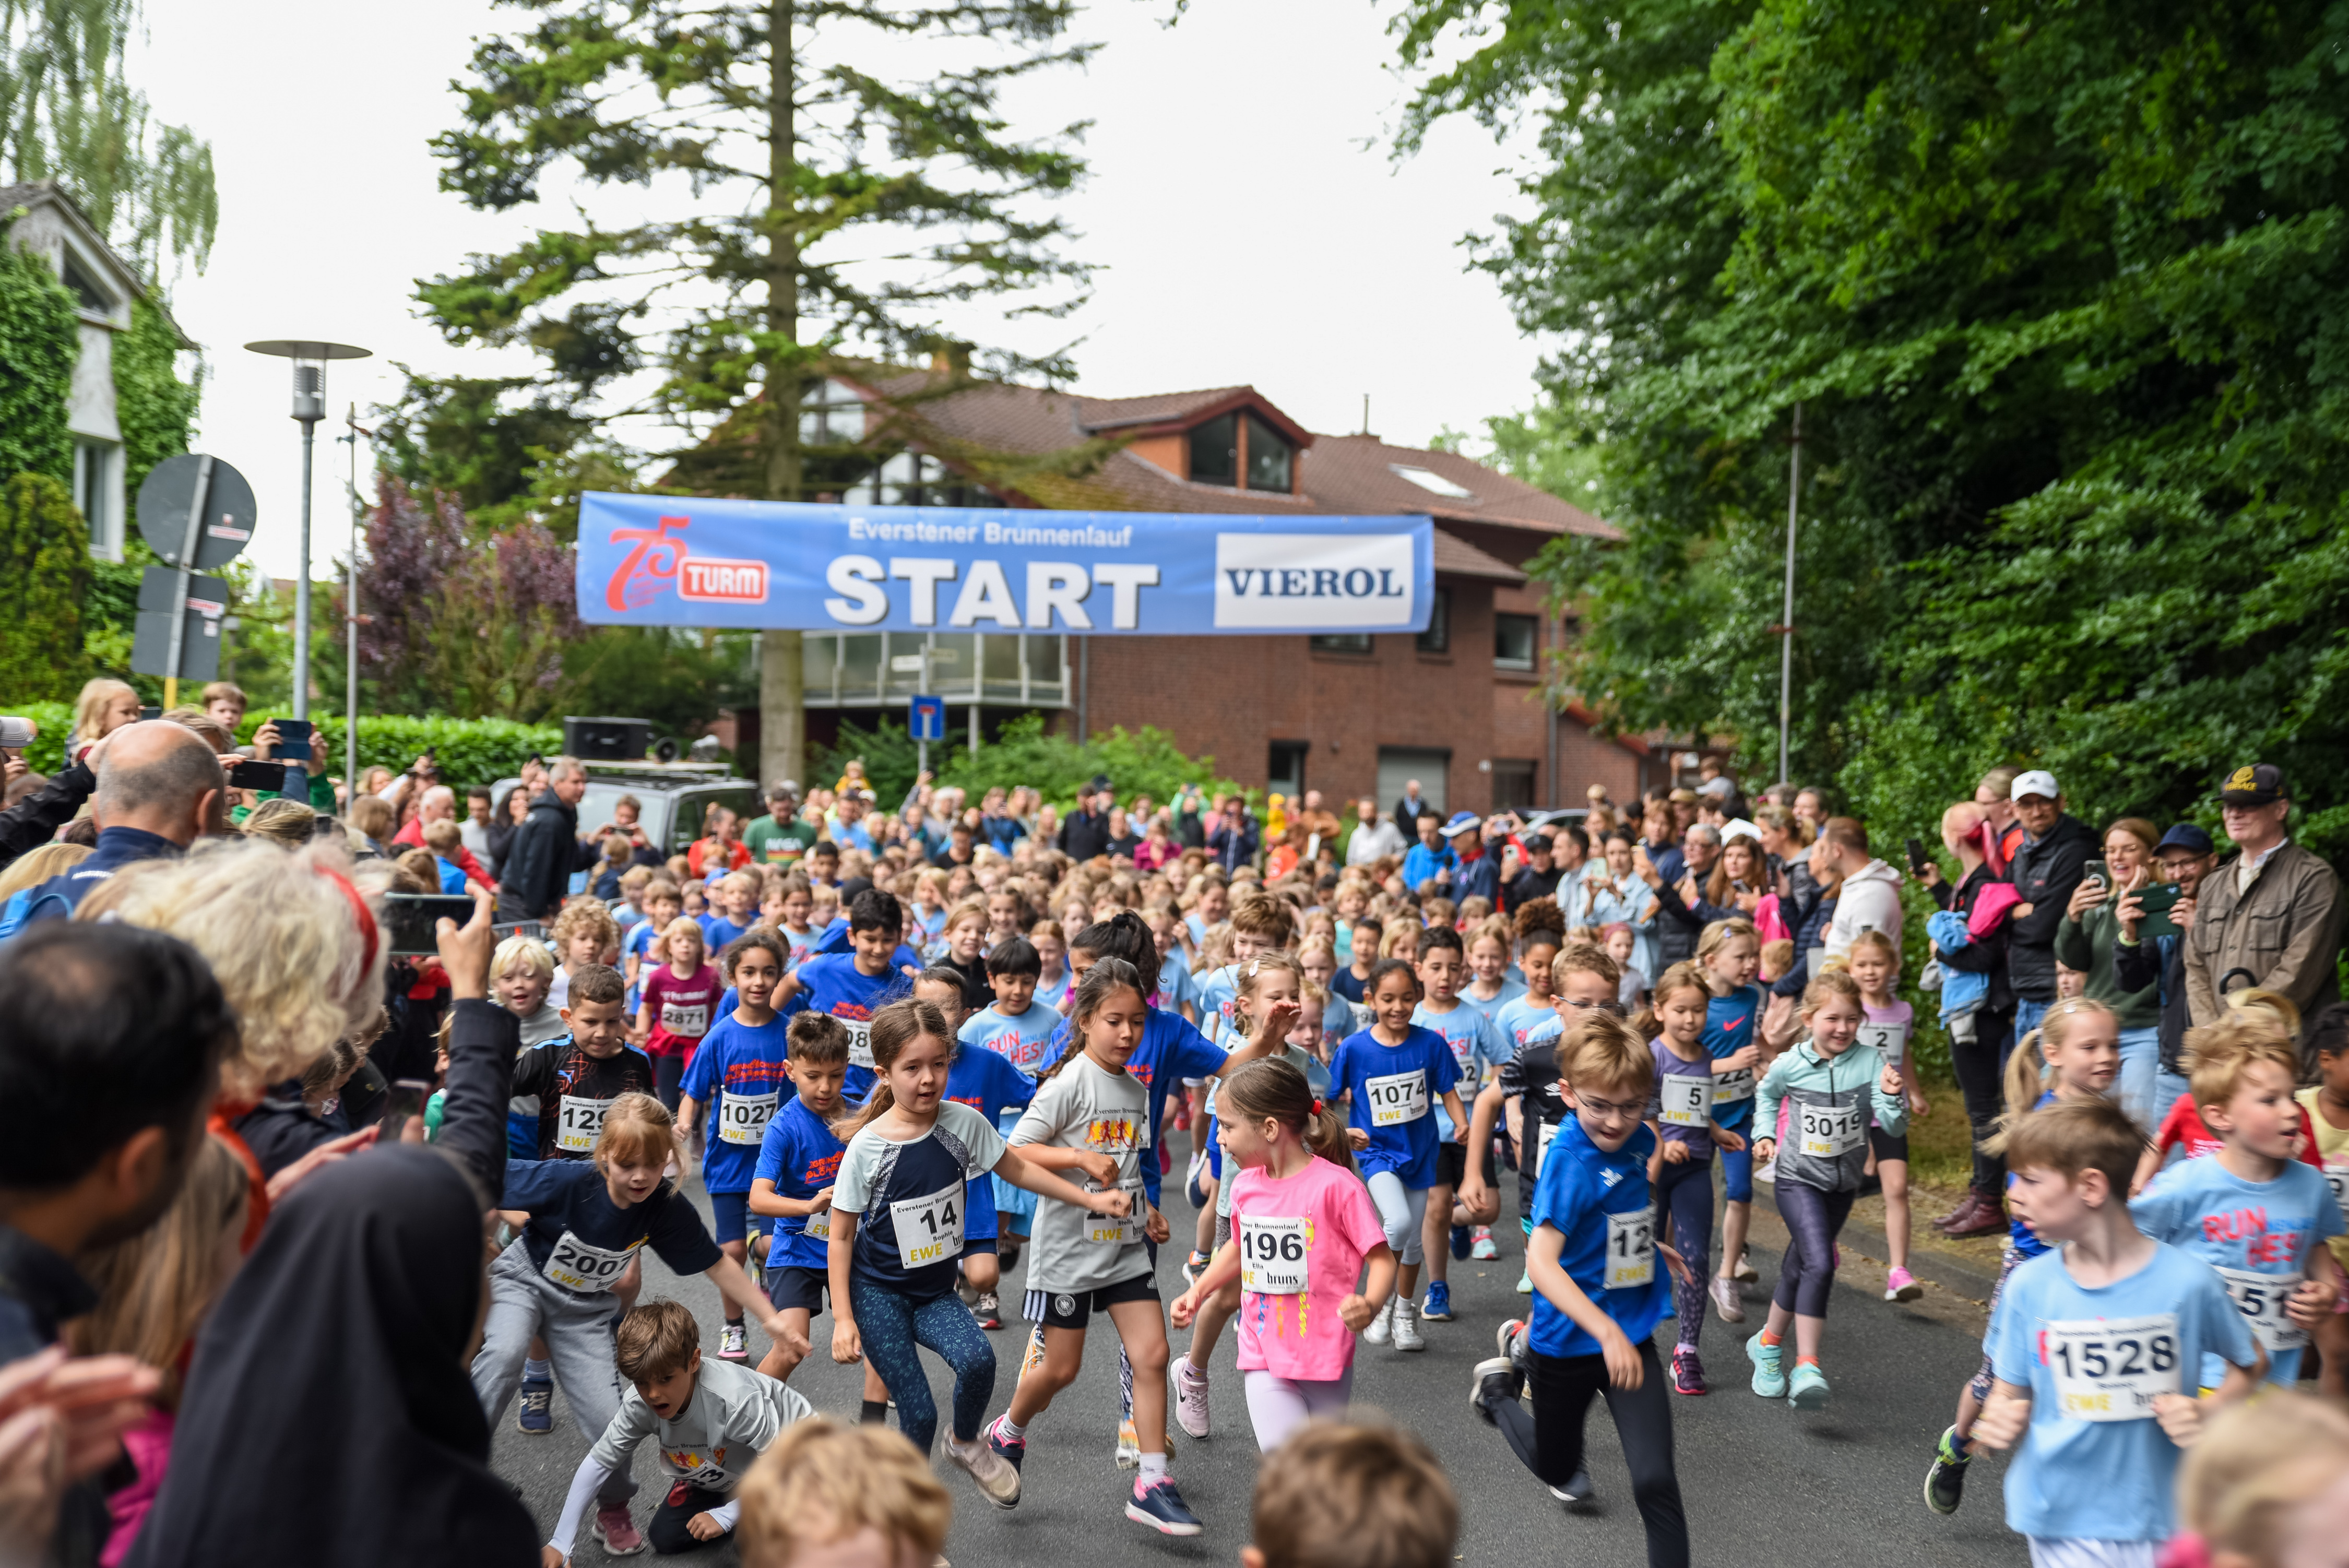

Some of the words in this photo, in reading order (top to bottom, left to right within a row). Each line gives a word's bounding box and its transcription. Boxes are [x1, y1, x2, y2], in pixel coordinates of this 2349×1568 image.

[849, 517, 978, 543] Everstener
[984, 522, 1133, 548] Brunnenlauf
[606, 515, 690, 612] 75
[686, 565, 761, 595] TURM
[1224, 567, 1405, 597] VIEROL
[824, 554, 1162, 631] START
[664, 1011, 704, 1024] 2871
[1876, 1031, 1888, 1047] 2
[1371, 1078, 1426, 1106] 1074
[1689, 1087, 1702, 1106] 5
[565, 1100, 595, 1108] Everstener
[723, 1102, 777, 1124] 1027
[1379, 1109, 1401, 1121] EWE
[564, 1135, 591, 1147] EWE
[724, 1128, 747, 1140] EWE
[897, 1201, 934, 1213] Everstener
[935, 1185, 962, 1204] Brunnenlauf
[920, 1200, 957, 1236] 14
[2202, 1206, 2268, 1243] RUN
[812, 1223, 829, 1236] EW
[933, 1230, 954, 1242] Sophie
[1093, 1227, 1123, 1241] EWE
[952, 1233, 964, 1247] bru
[1243, 1231, 1303, 1261] 196
[910, 1242, 943, 1262] EWE
[551, 1269, 586, 1288] EWE
[1242, 1269, 1255, 1285] WE
[1267, 1271, 1299, 1285] bruns
[2055, 1335, 2176, 1380] 1528
